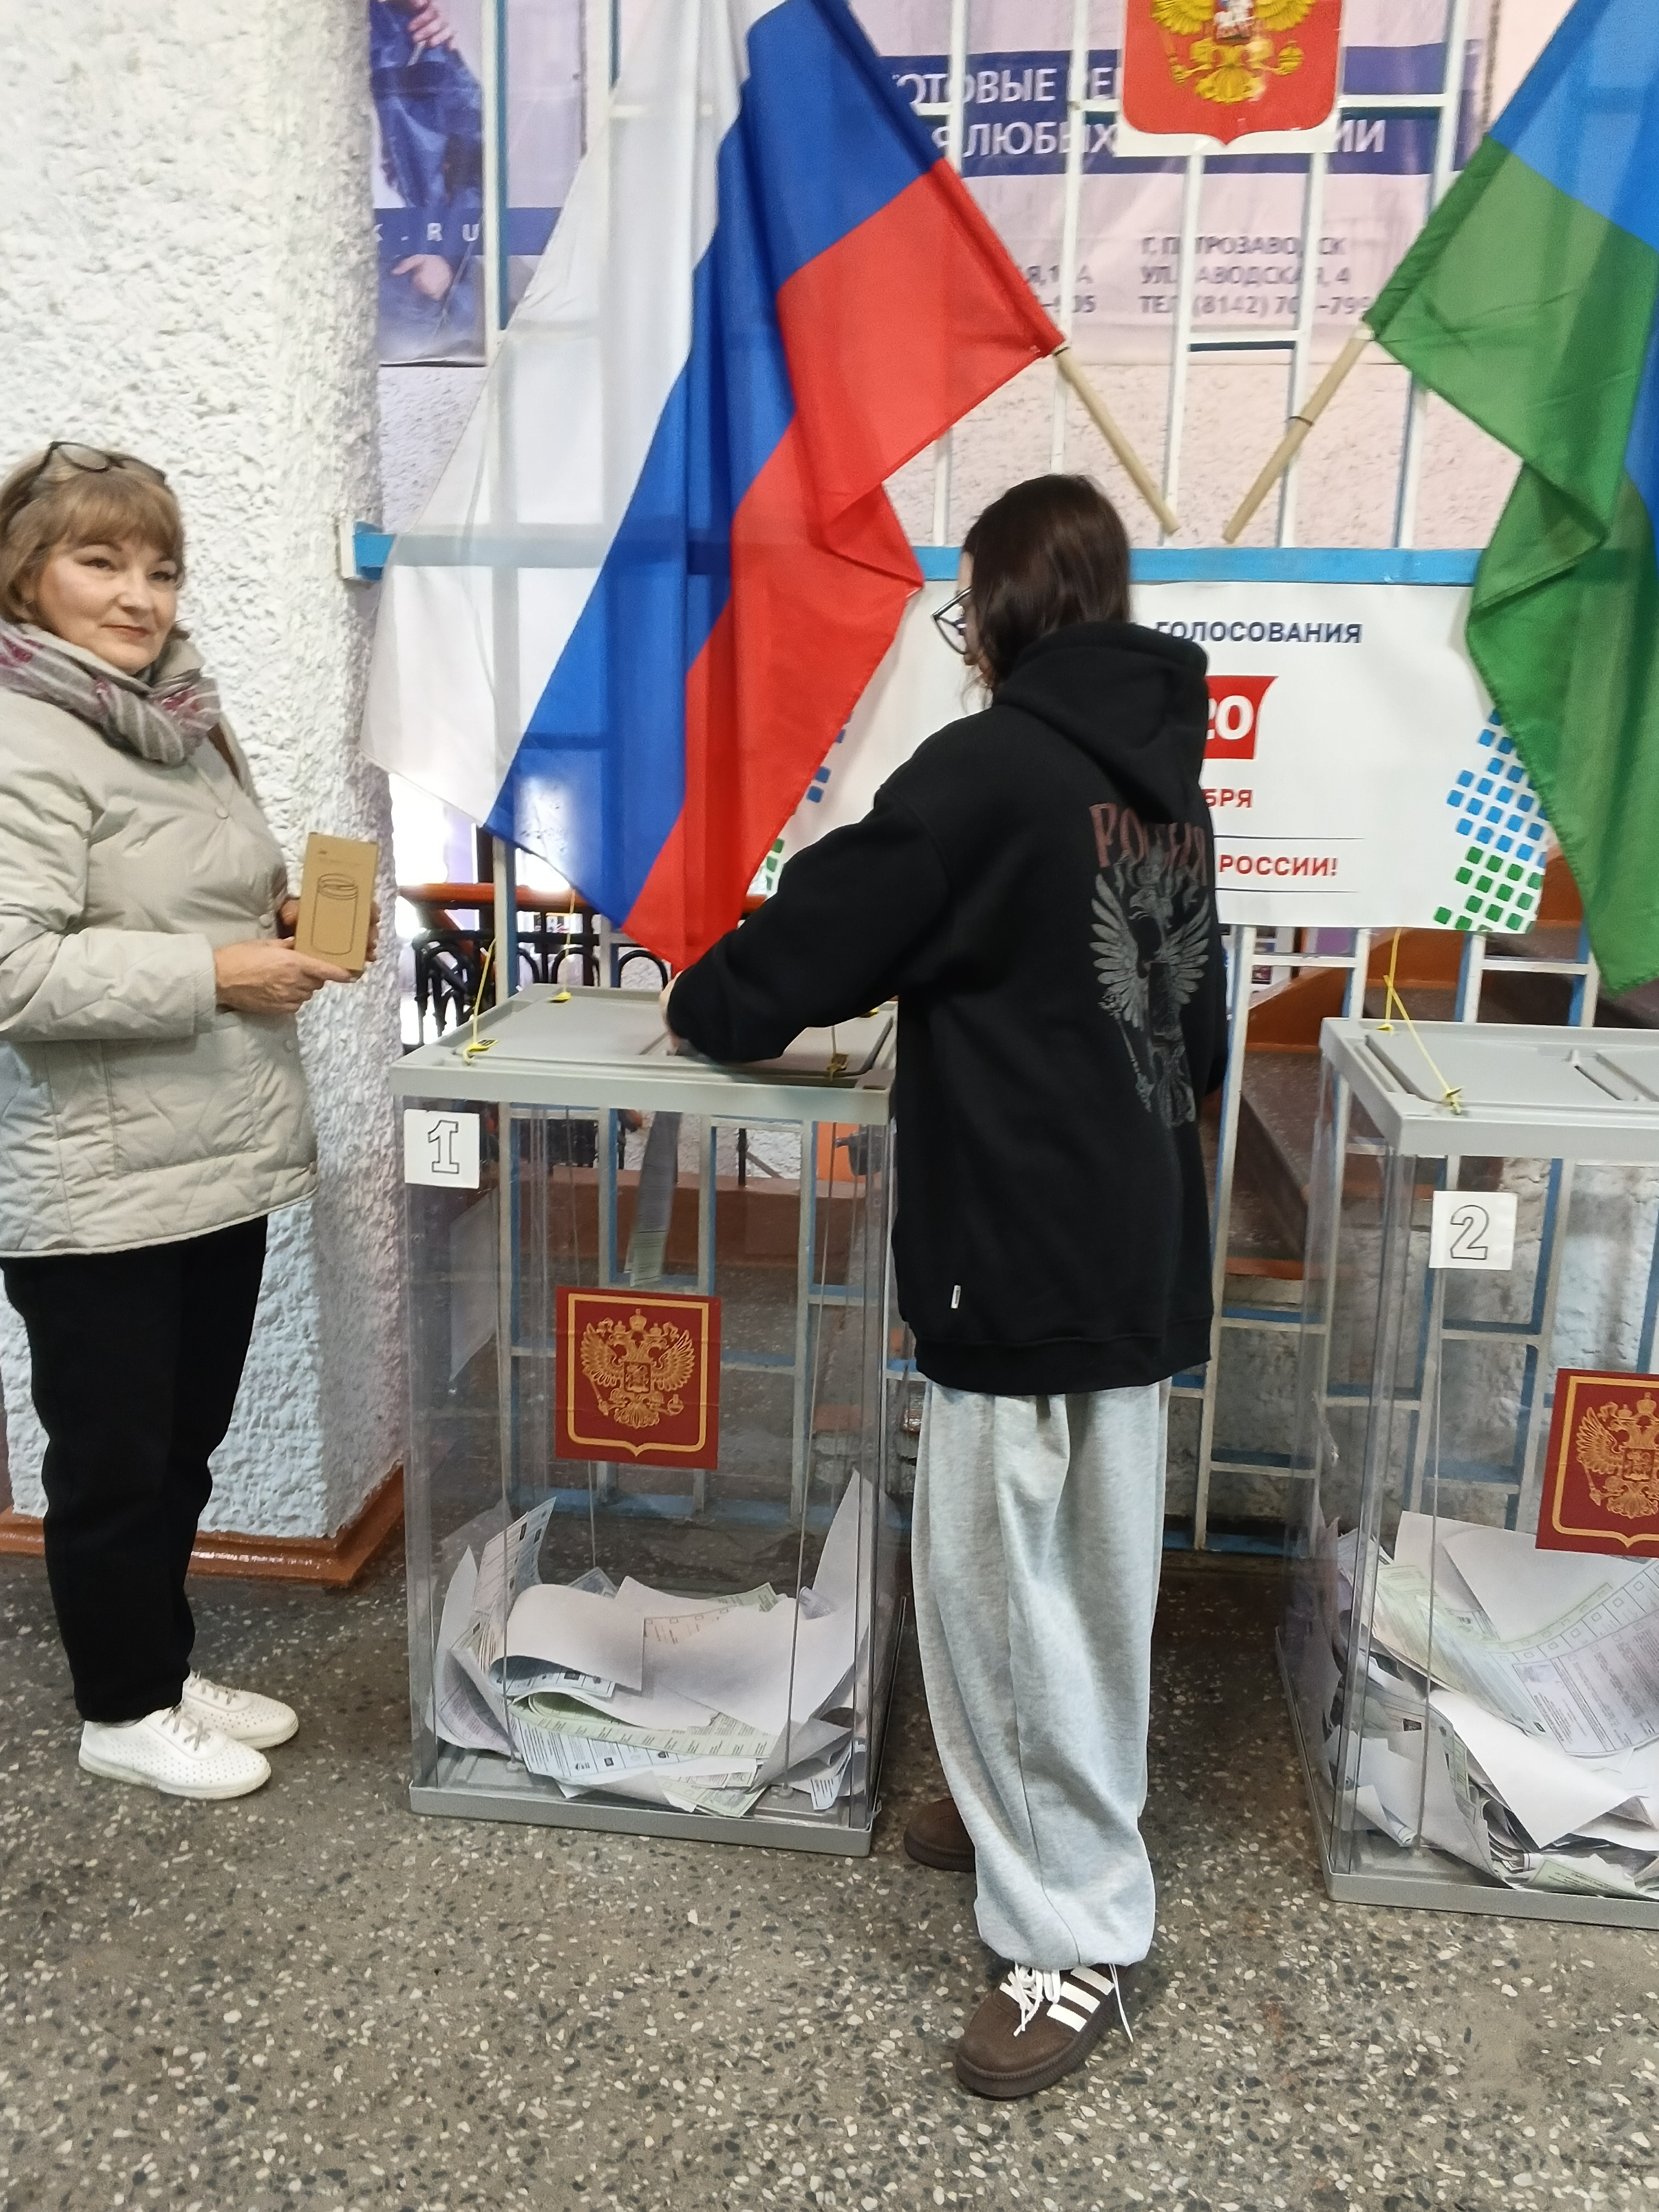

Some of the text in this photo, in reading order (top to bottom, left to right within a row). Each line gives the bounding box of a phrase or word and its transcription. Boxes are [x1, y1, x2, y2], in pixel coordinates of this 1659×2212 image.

[893, 68, 1058, 103] ОТОВЫЕ
[962, 121, 1119, 157] ЛЮБЫХ
[1162, 236, 1346, 257] ПТРОЗАВОСК
[1156, 621, 1362, 643] ГОЛОСОВАНИЯ
[1219, 855, 1337, 877] РОССИИ!
[428, 1119, 460, 1175] 1
[1450, 1205, 1489, 1261] 2
